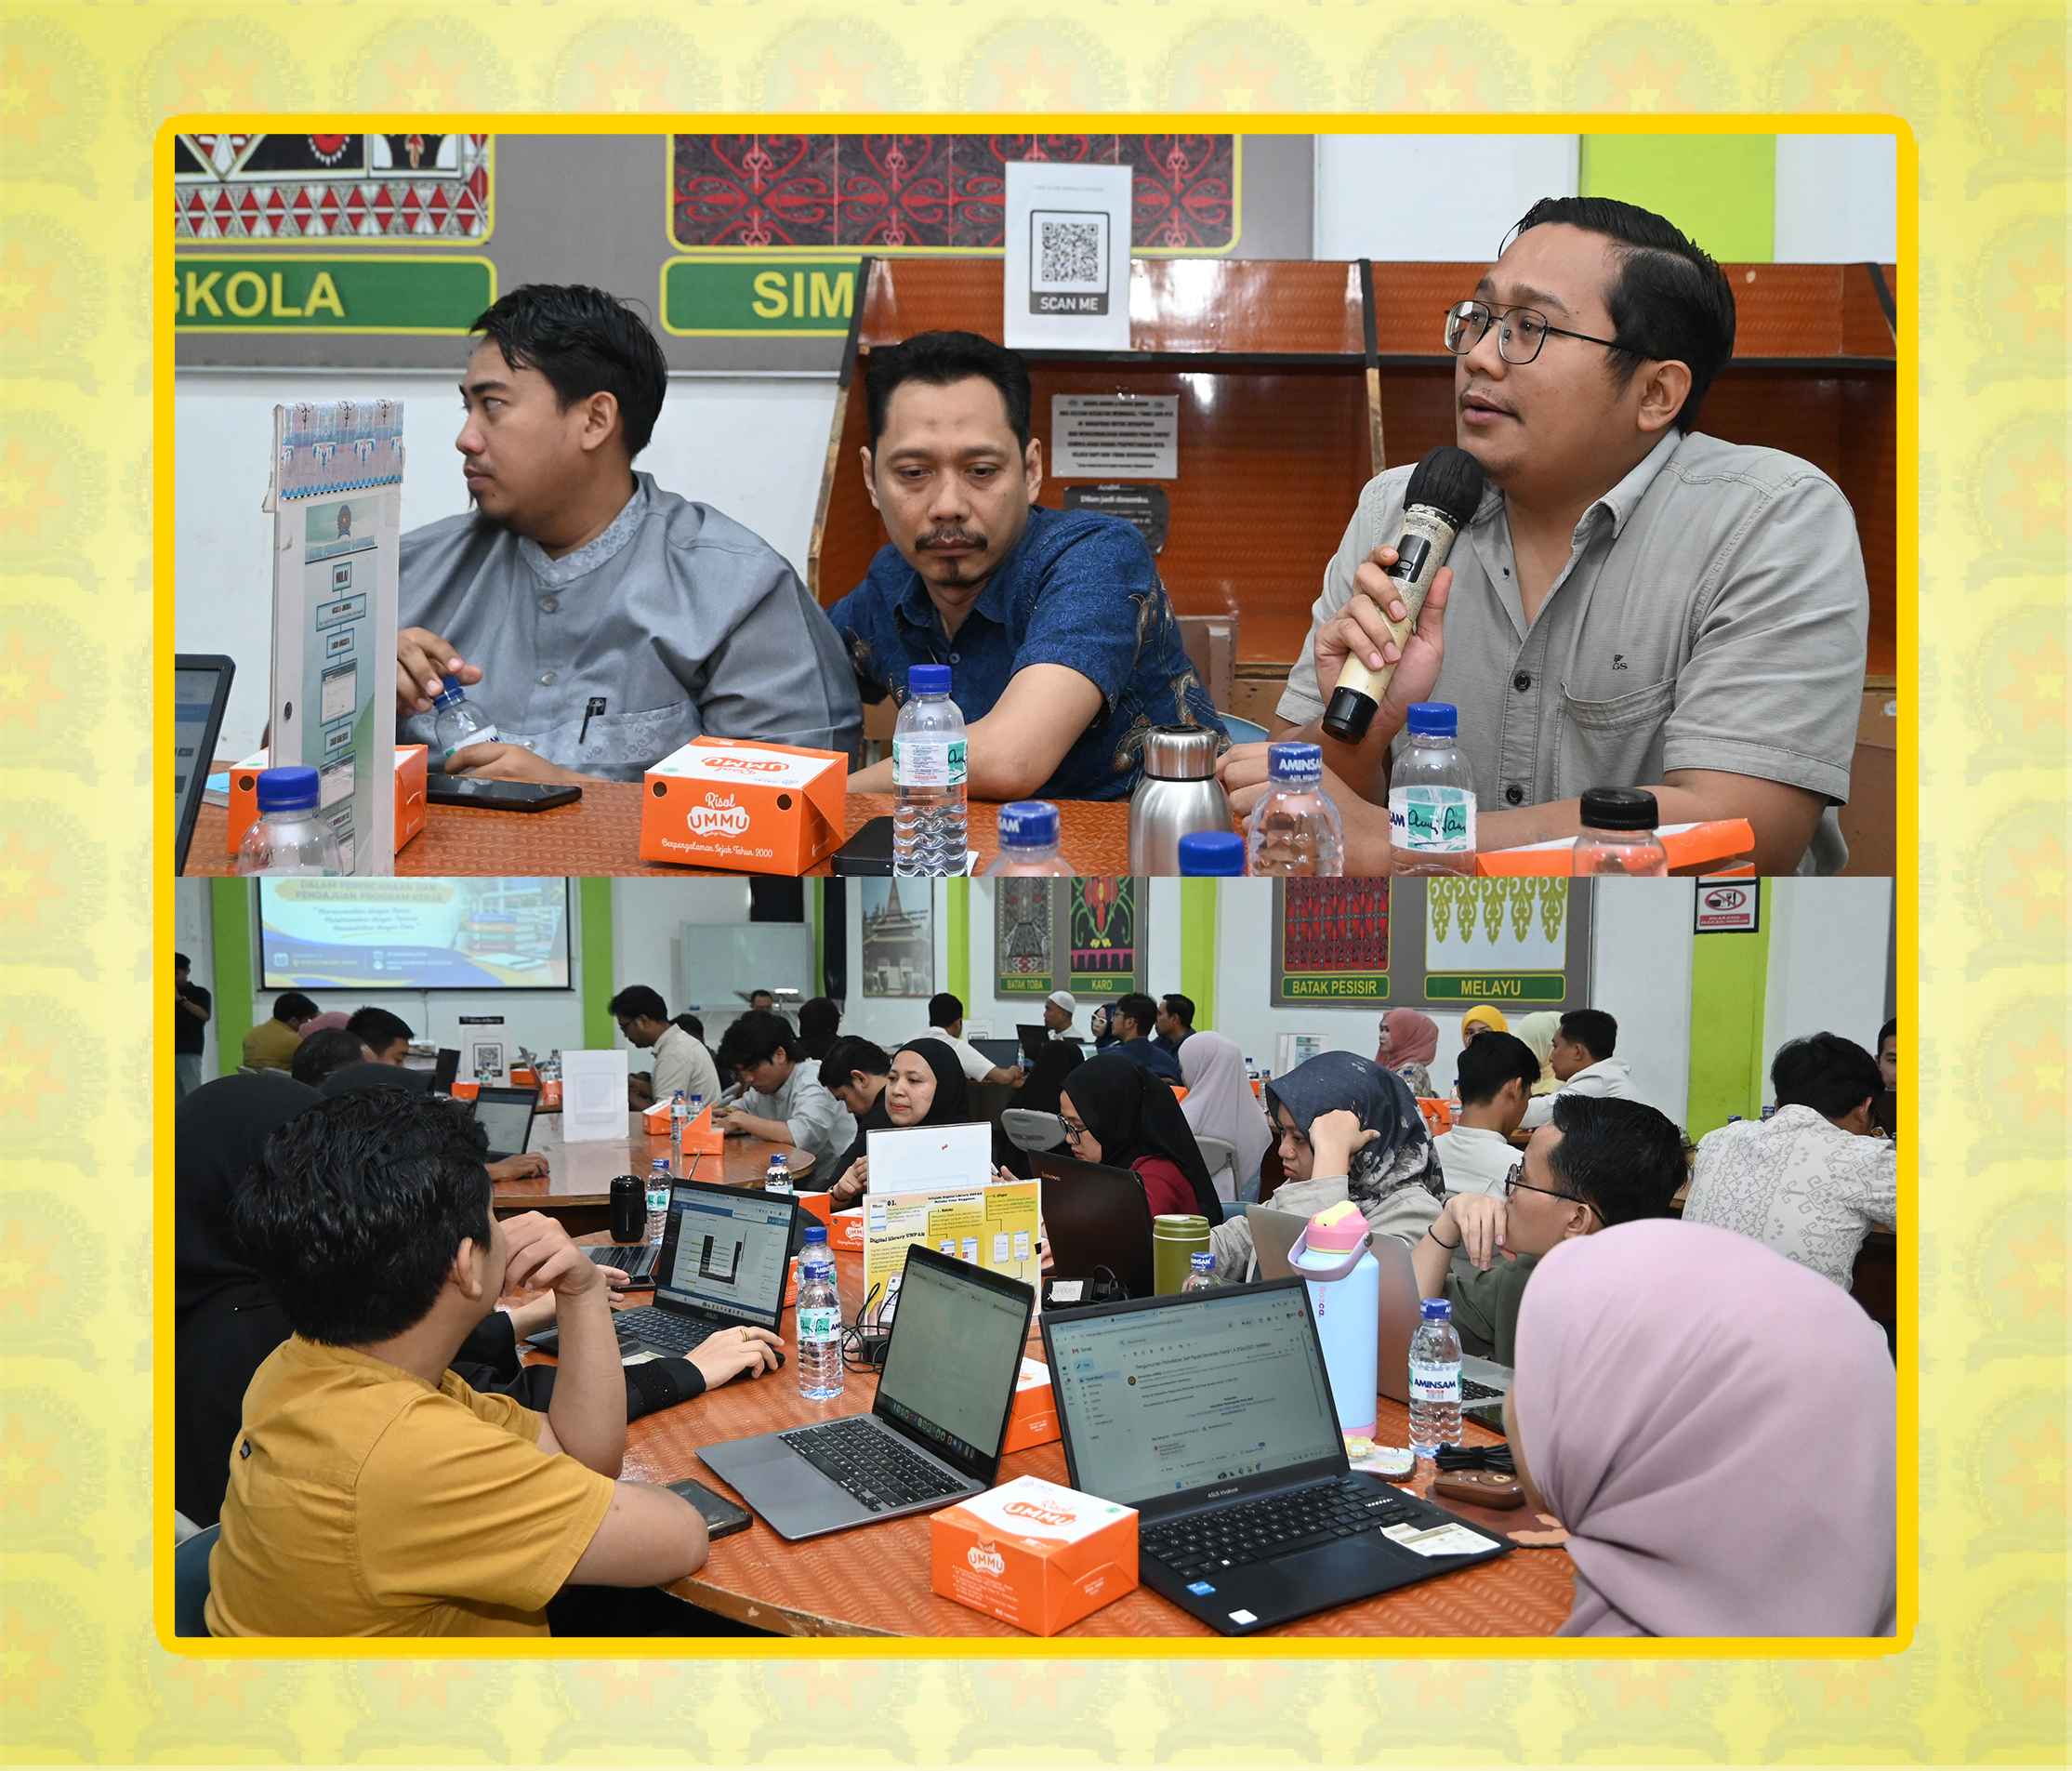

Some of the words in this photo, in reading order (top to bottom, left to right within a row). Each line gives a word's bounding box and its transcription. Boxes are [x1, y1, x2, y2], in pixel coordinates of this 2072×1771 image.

[175, 271, 345, 317] KOLA
[1040, 297, 1076, 311] SCAN
[1079, 297, 1099, 311] ME
[1279, 759, 1322, 771] AMINSA
[706, 792, 735, 809] Risol
[690, 813, 747, 829] UMMU
[715, 843, 732, 856] Sejak
[732, 846, 754, 856] Tahun
[755, 848, 772, 857] 2000
[1091, 979, 1113, 990] KARO
[1292, 981, 1328, 994] BATAK
[1331, 981, 1377, 994] PESISIR
[1460, 981, 1521, 996] MELAYU
[1414, 1380, 1457, 1389] AMINSAM
[1004, 1503, 1076, 1525] UMMU
[970, 1553, 1003, 1571] UMMU
